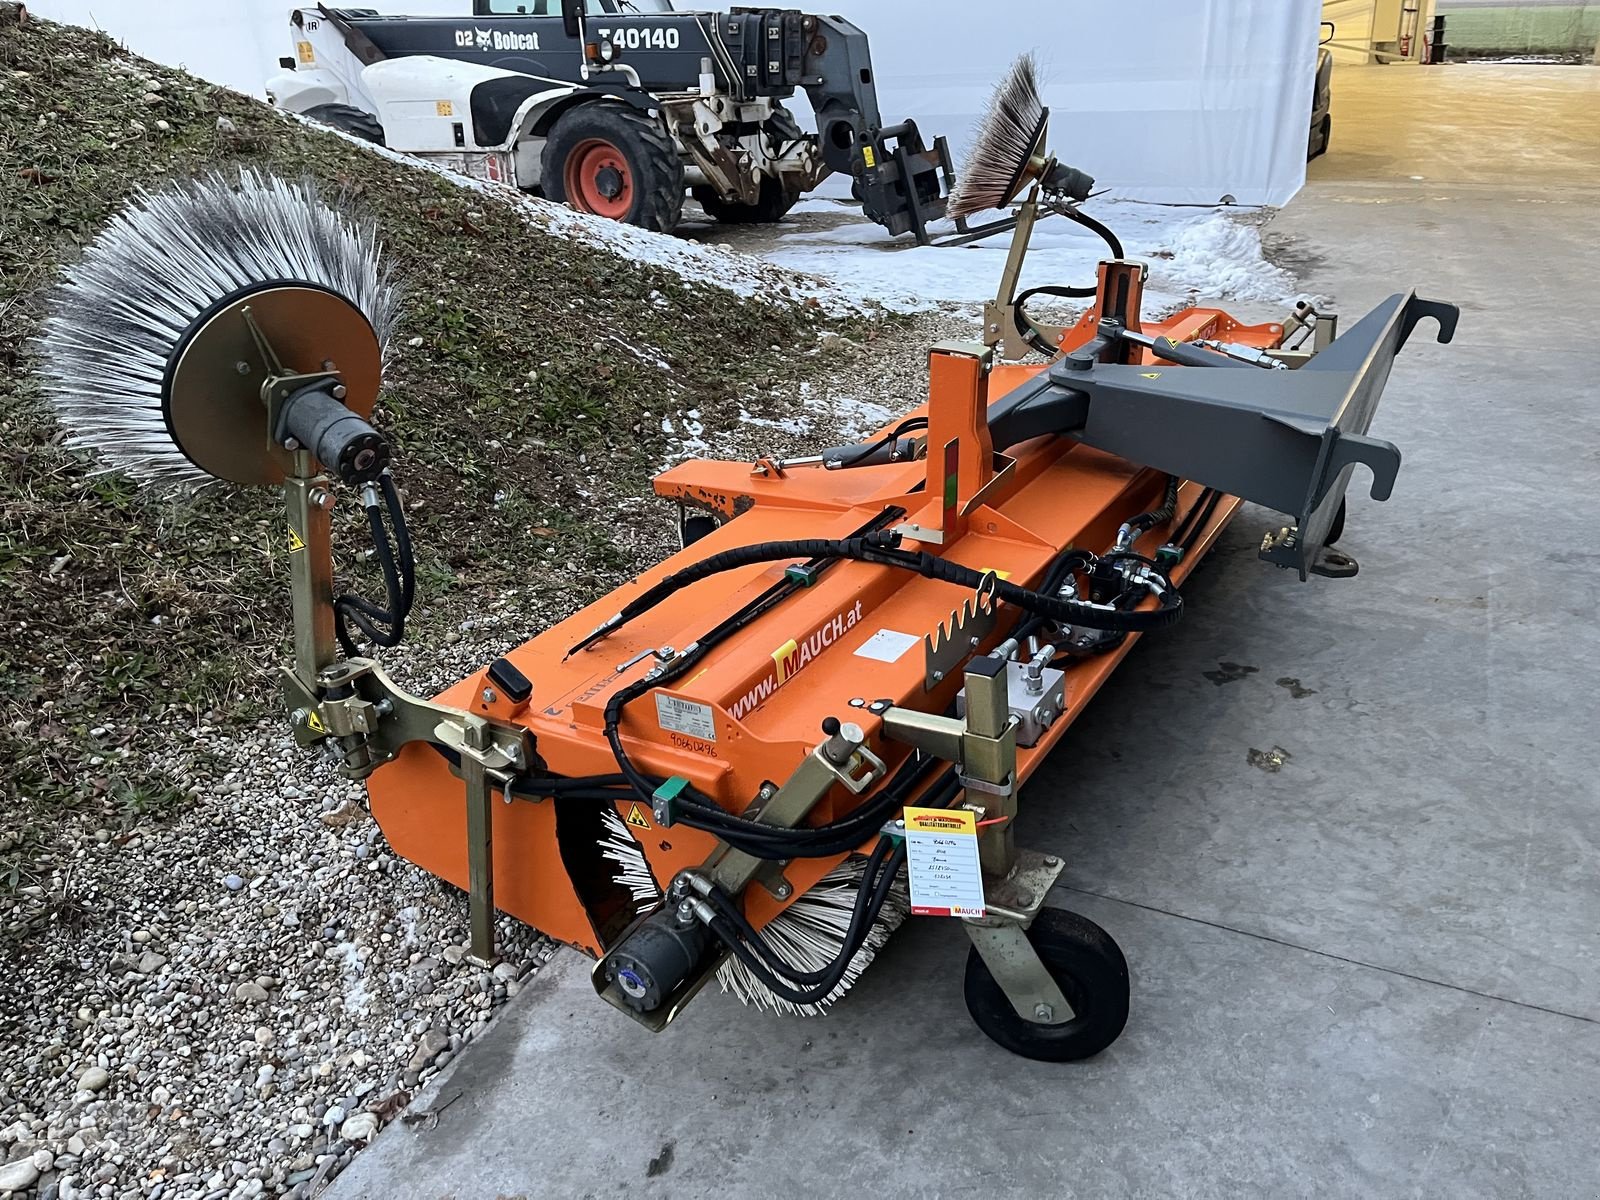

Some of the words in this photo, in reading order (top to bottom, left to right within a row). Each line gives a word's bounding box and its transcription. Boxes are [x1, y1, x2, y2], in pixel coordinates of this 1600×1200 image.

[308, 21, 317, 31] IR
[455, 30, 474, 47] 02
[493, 31, 540, 51] Bobcat
[598, 28, 680, 49] T40140
[727, 599, 863, 721] www.MAUCH.at
[954, 907, 981, 916] MAUCH
